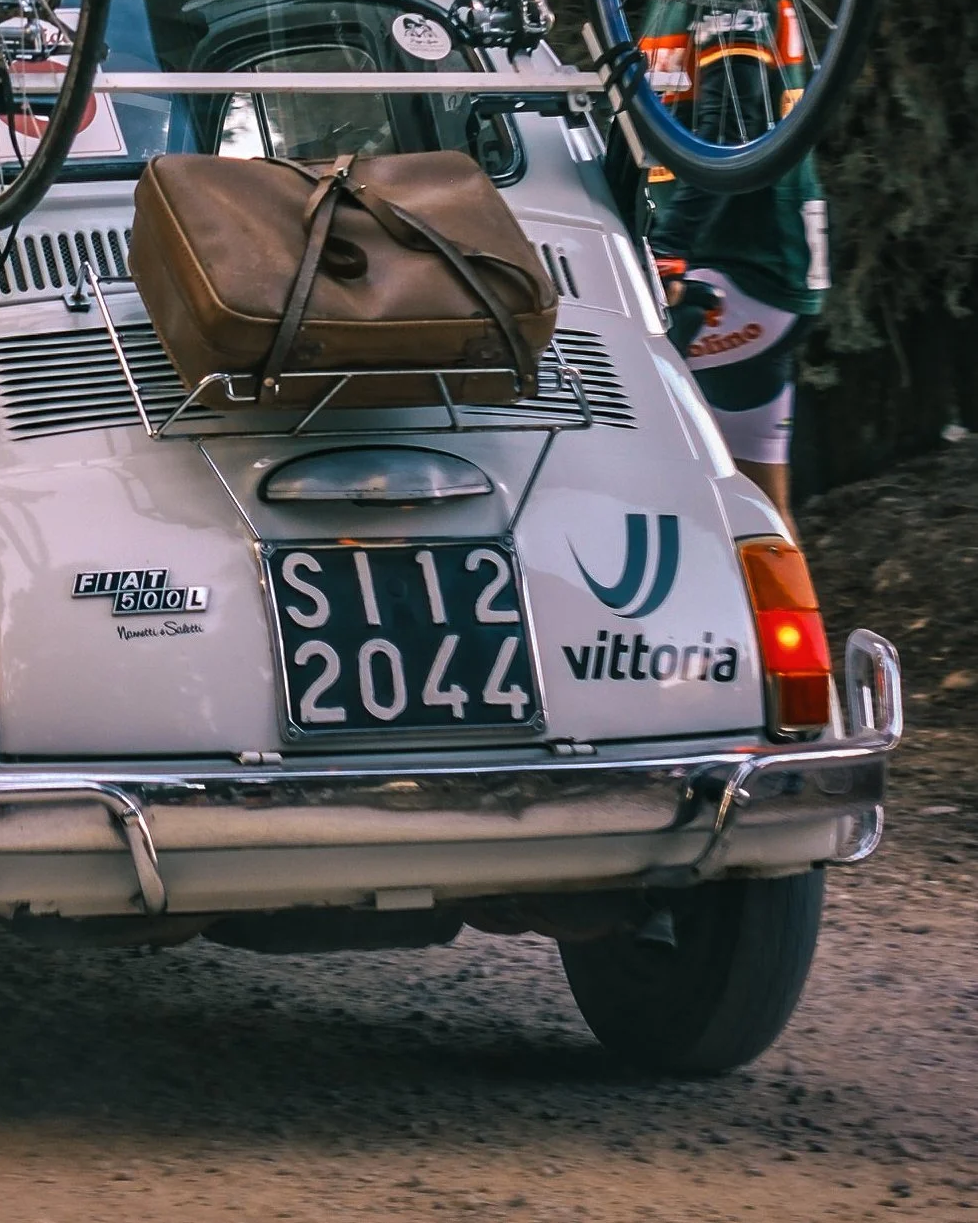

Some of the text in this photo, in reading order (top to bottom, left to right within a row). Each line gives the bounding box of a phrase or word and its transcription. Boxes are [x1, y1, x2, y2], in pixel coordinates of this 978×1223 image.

[78, 570, 164, 593] FIAT
[294, 633, 530, 723] 2044
[561, 630, 739, 683] vittoria
